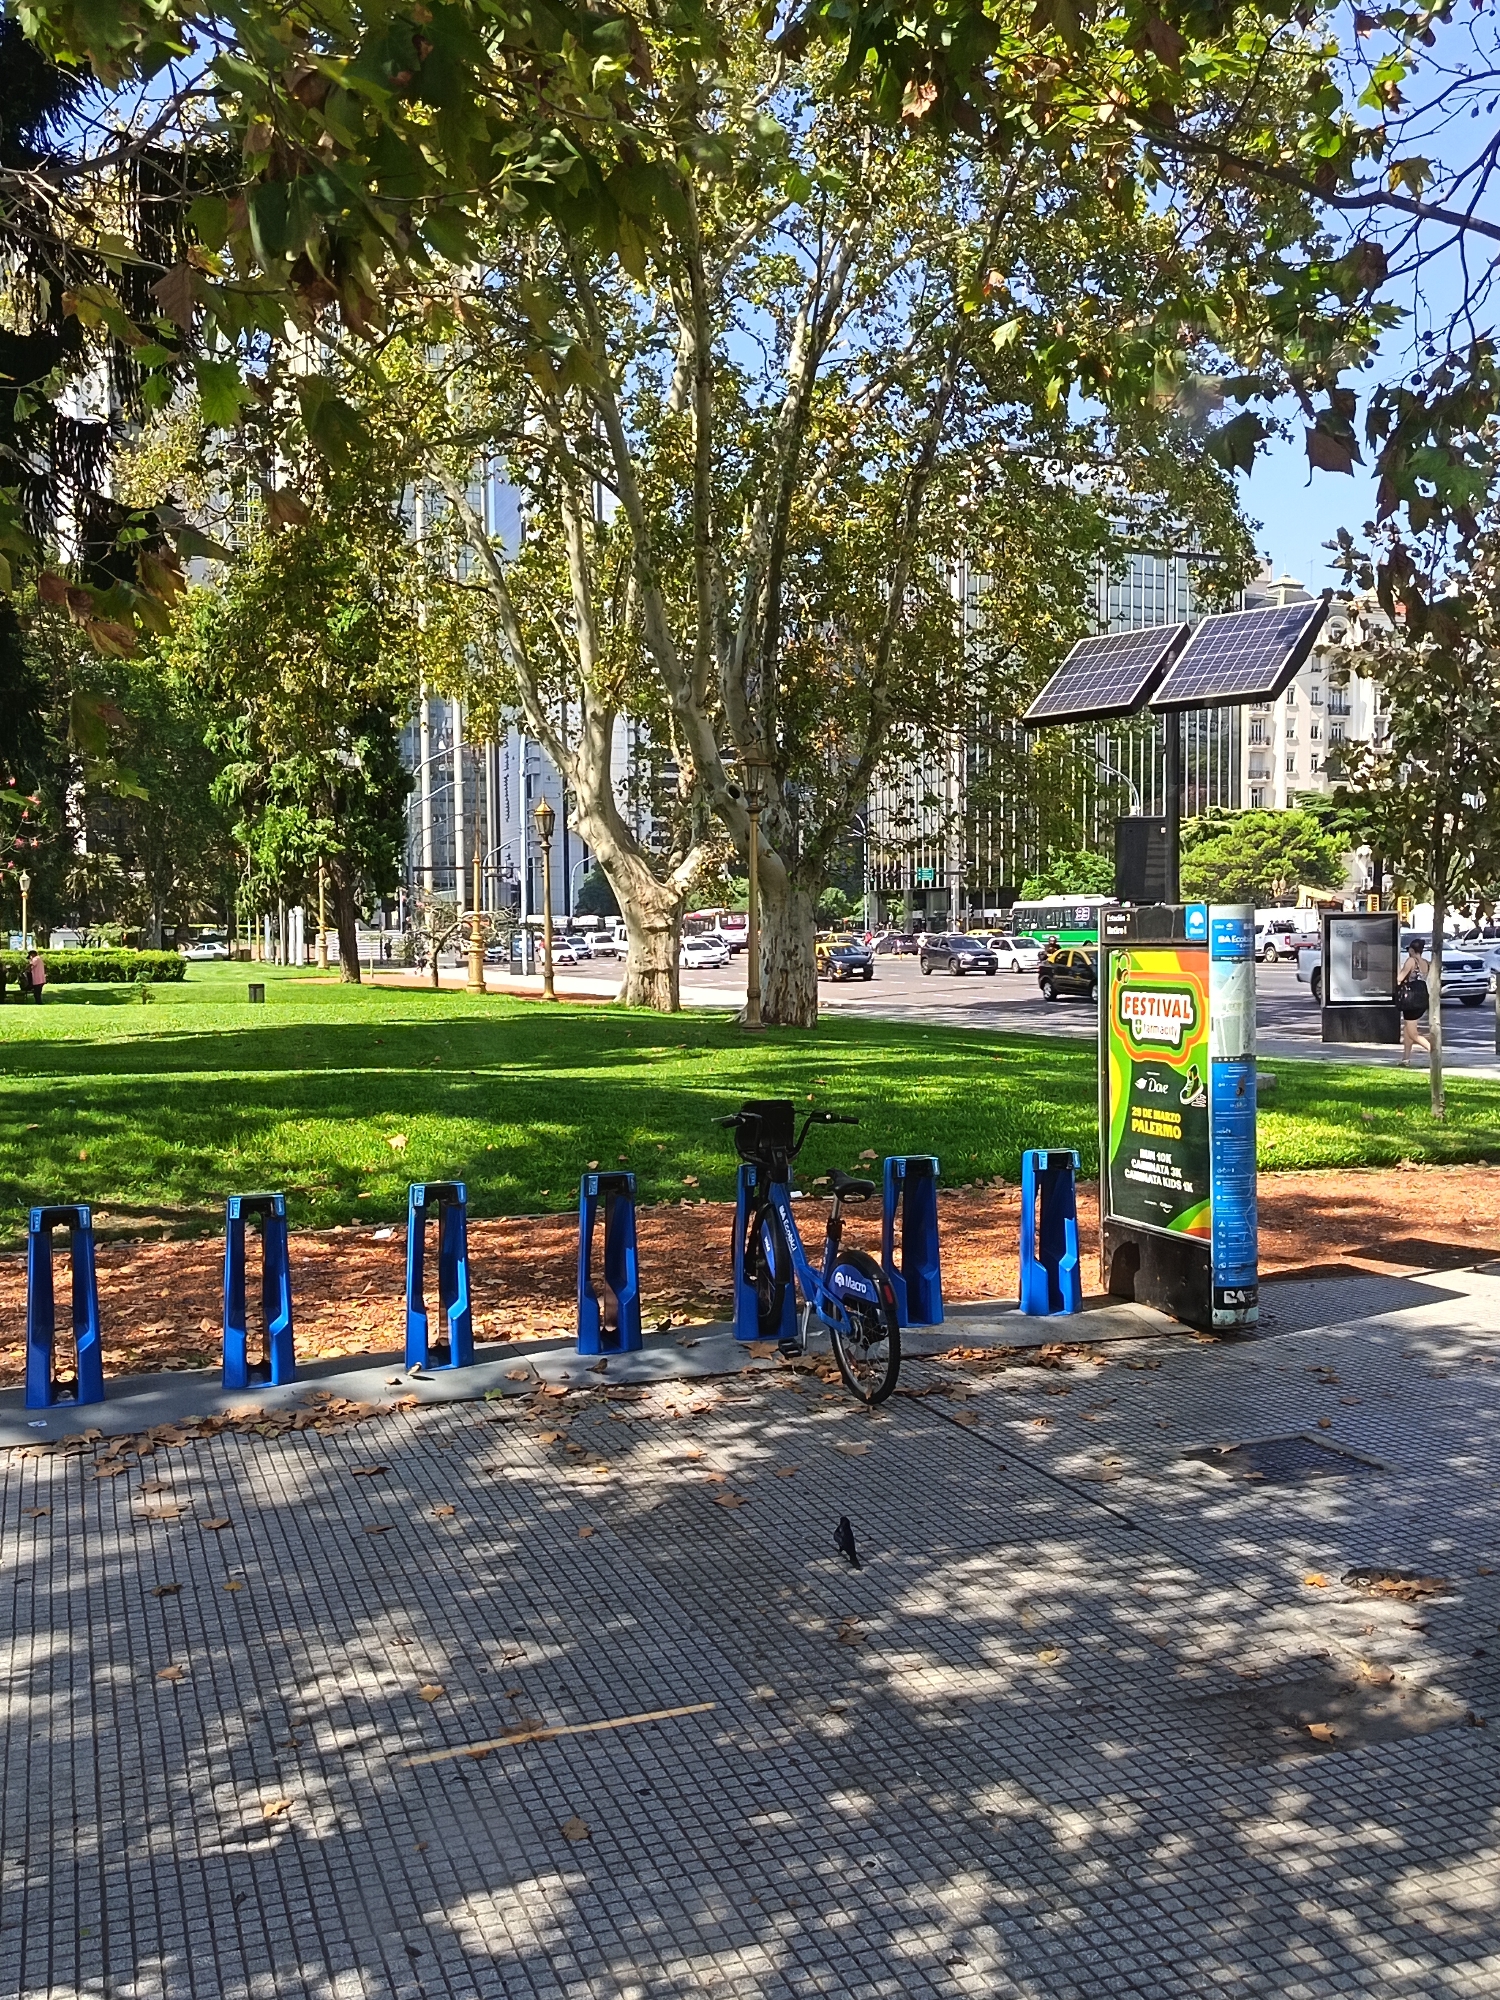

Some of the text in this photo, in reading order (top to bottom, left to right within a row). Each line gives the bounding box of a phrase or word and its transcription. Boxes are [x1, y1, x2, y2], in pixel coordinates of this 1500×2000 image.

[1125, 996, 1190, 1019] FESTIVAL
[1142, 1107, 1153, 1119] DE
[1153, 1109, 1182, 1124] MARZO
[1131, 1118, 1182, 1140] PALERMO
[1156, 1151, 1172, 1164] 10K
[1131, 1158, 1183, 1179] CAMINATA 3K
[1124, 1168, 1194, 1194] CAMINATA KIDS 1K
[783, 1218, 798, 1252] Ecobici
[845, 1274, 867, 1294] Macro
